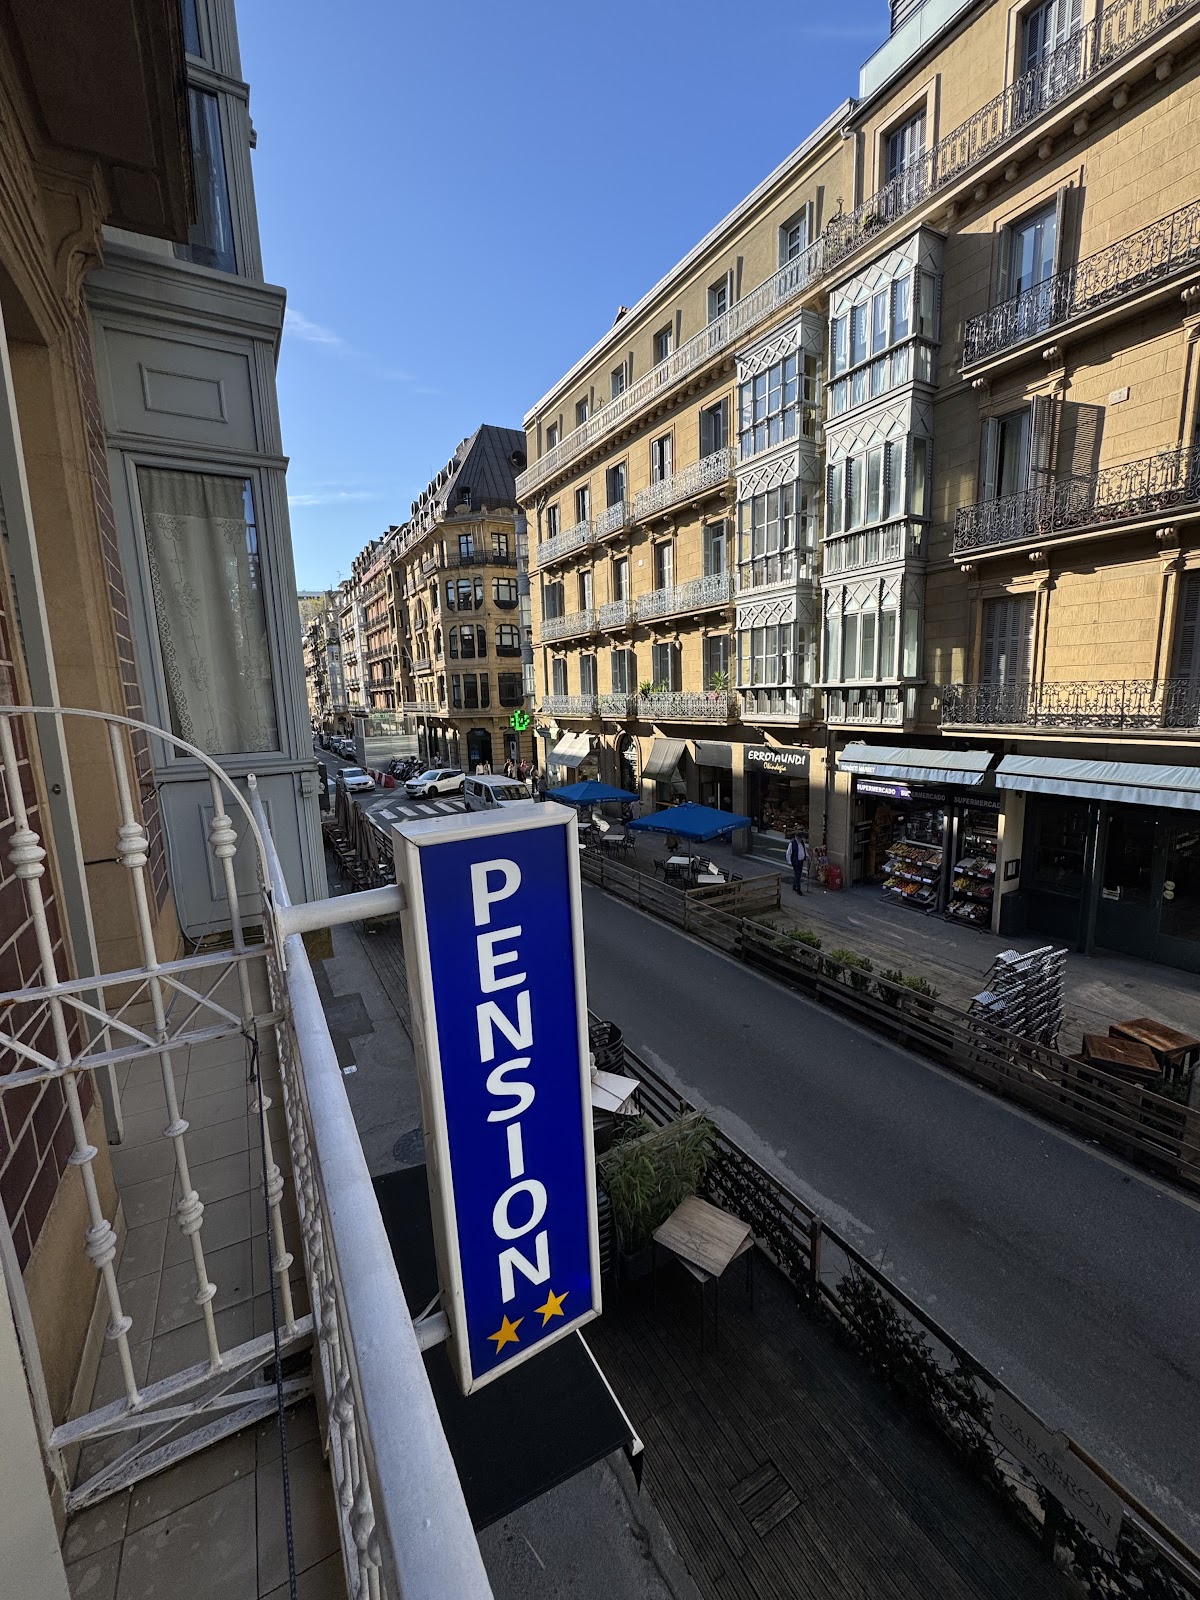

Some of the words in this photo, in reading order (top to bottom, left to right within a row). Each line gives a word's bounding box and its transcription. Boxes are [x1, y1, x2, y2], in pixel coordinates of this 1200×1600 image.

[748, 750, 806, 766] ERROTAUNDI
[859, 765, 876, 773] MARKET
[857, 784, 896, 795] SUPERMERCADO
[953, 796, 1000, 808] SUPERMERCAD
[470, 858, 551, 1304] PENSION
